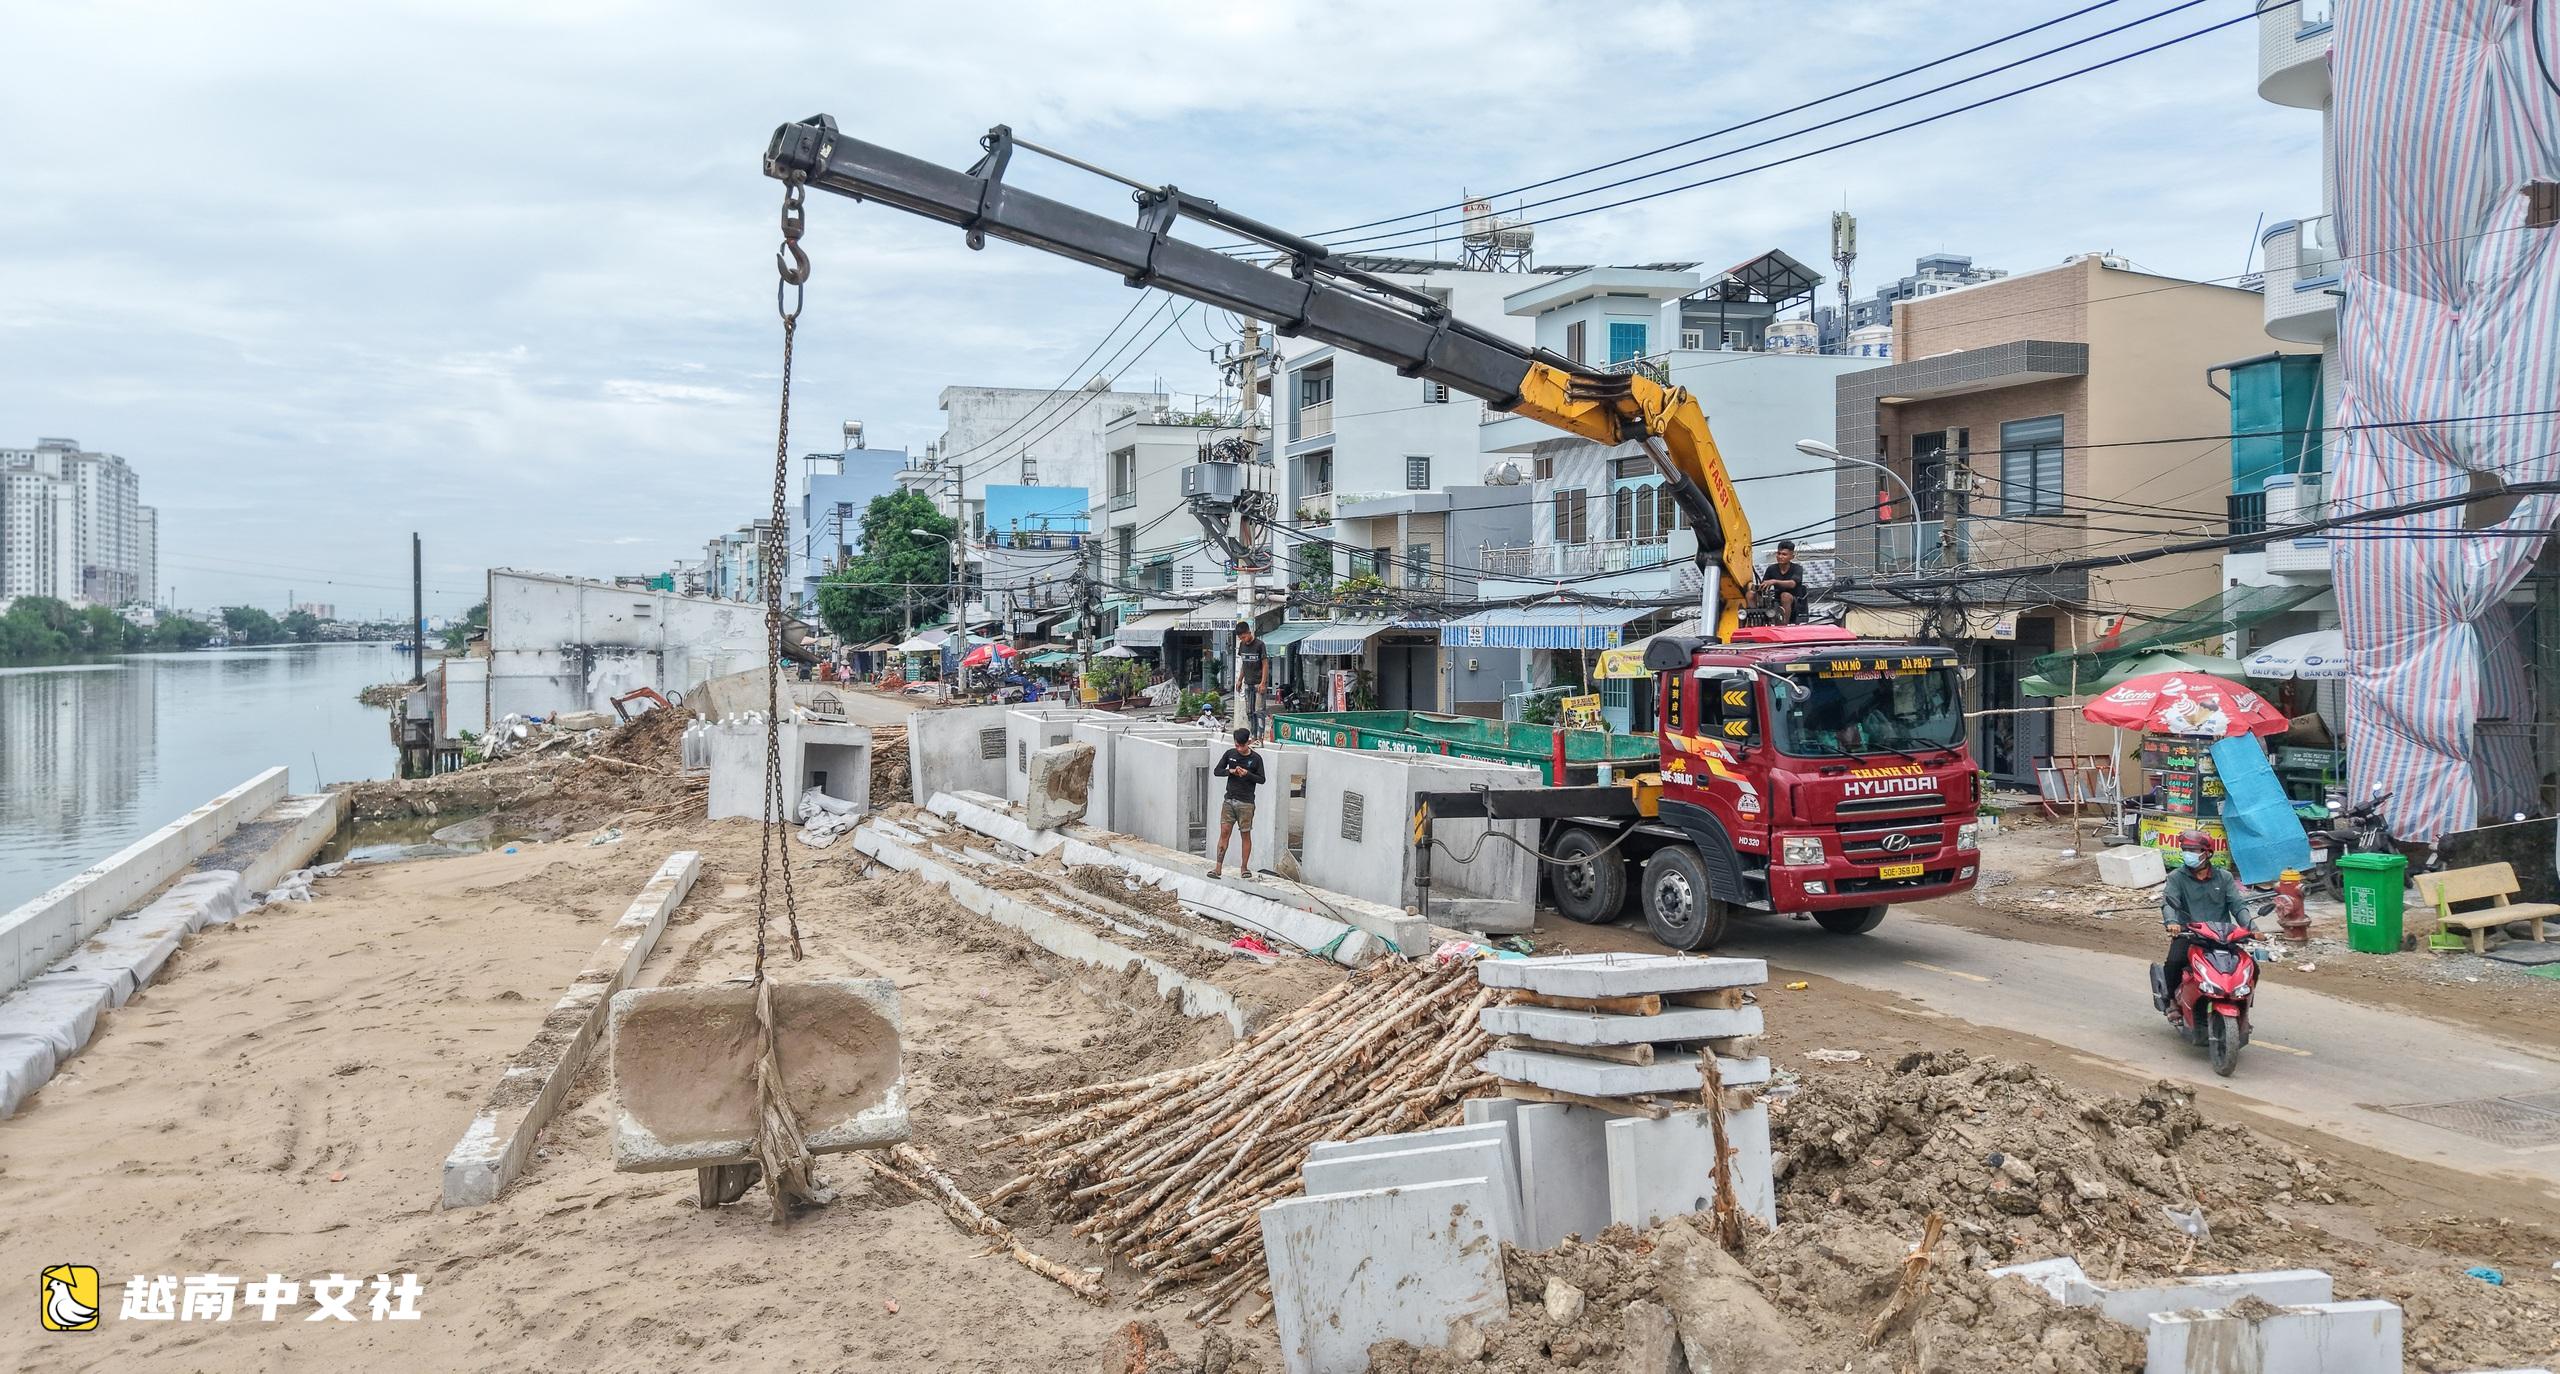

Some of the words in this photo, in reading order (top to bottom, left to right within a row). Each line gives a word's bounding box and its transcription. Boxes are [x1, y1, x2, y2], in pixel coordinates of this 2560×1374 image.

[1708, 458, 1729, 508] FASSI
[1831, 660, 1849, 671] NAM
[1849, 658, 1861, 670] MÔ
[1874, 660, 1888, 670] ADI
[2105, 687, 2157, 702] Merino
[1295, 726, 1330, 746] HYUNDAI
[1851, 766, 1903, 779] THANH
[1902, 762, 1924, 775] VŨ
[1844, 776, 1938, 796] HYUNDAI
